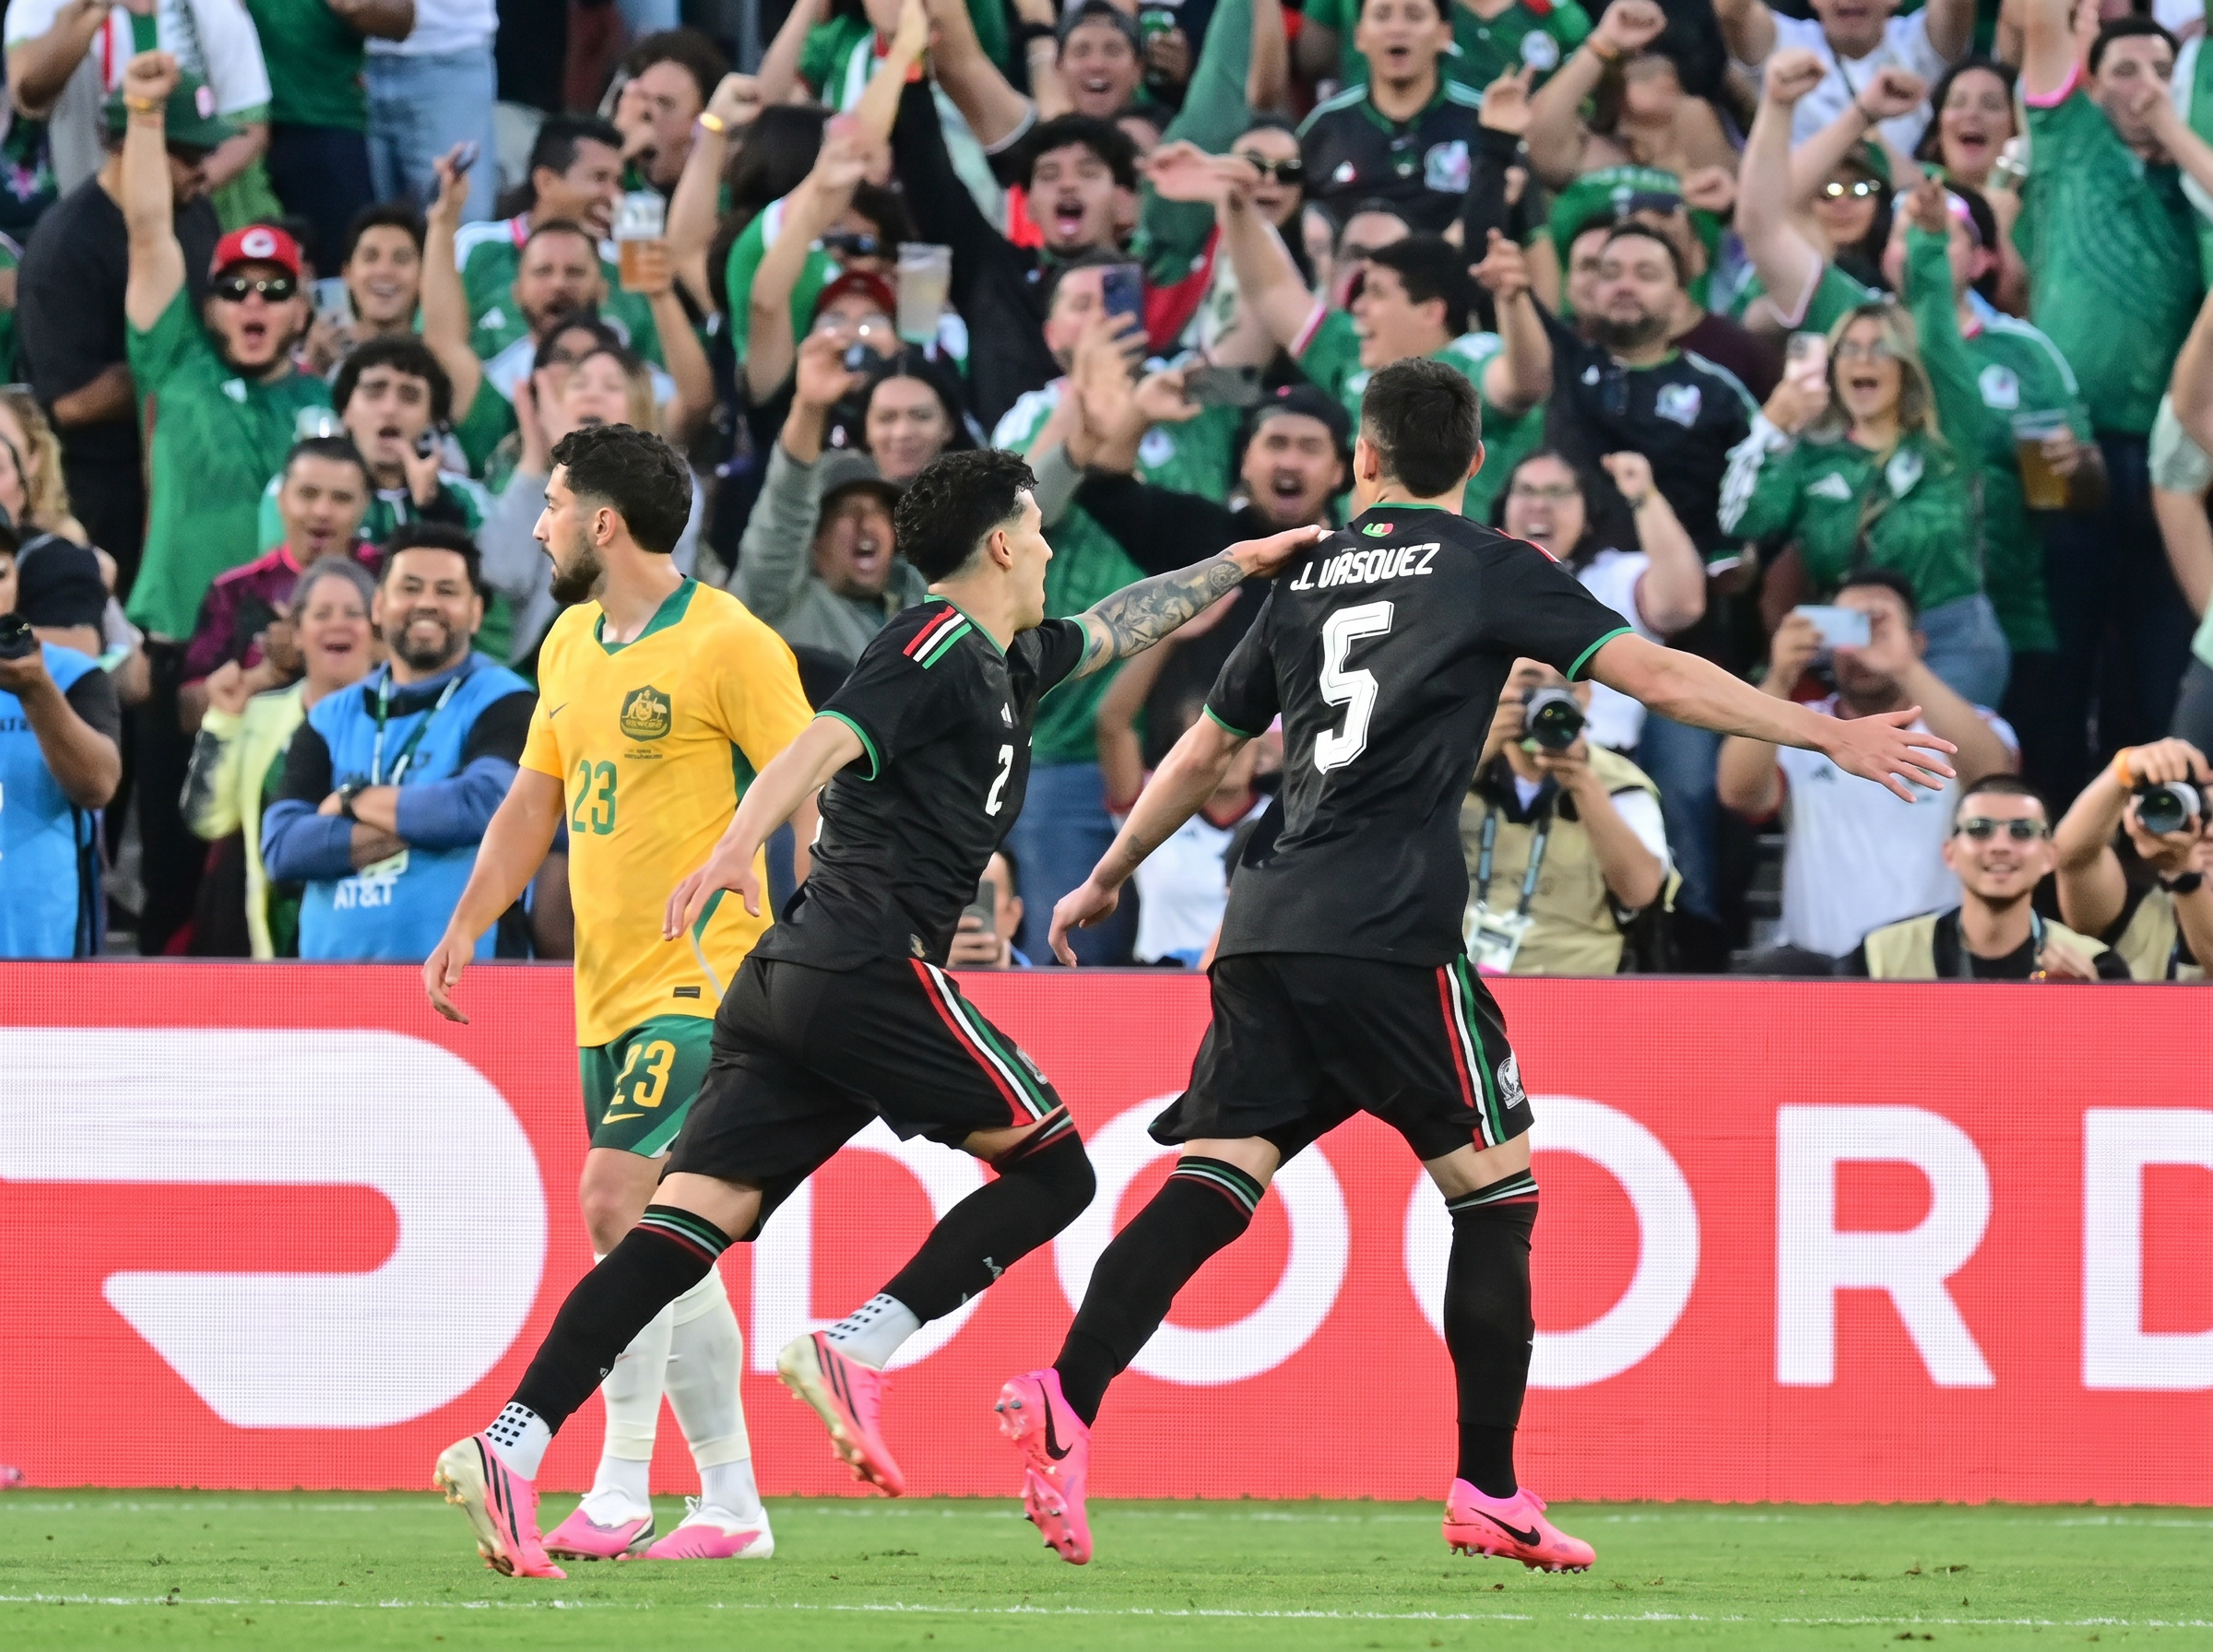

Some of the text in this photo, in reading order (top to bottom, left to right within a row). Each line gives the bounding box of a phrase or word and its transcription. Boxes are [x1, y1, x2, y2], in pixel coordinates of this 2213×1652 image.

[1314, 600, 1395, 775] 5
[572, 759, 618, 835] 23
[985, 744, 1014, 817] 2
[334, 876, 398, 911] AT&T
[609, 1040, 677, 1107] 23
